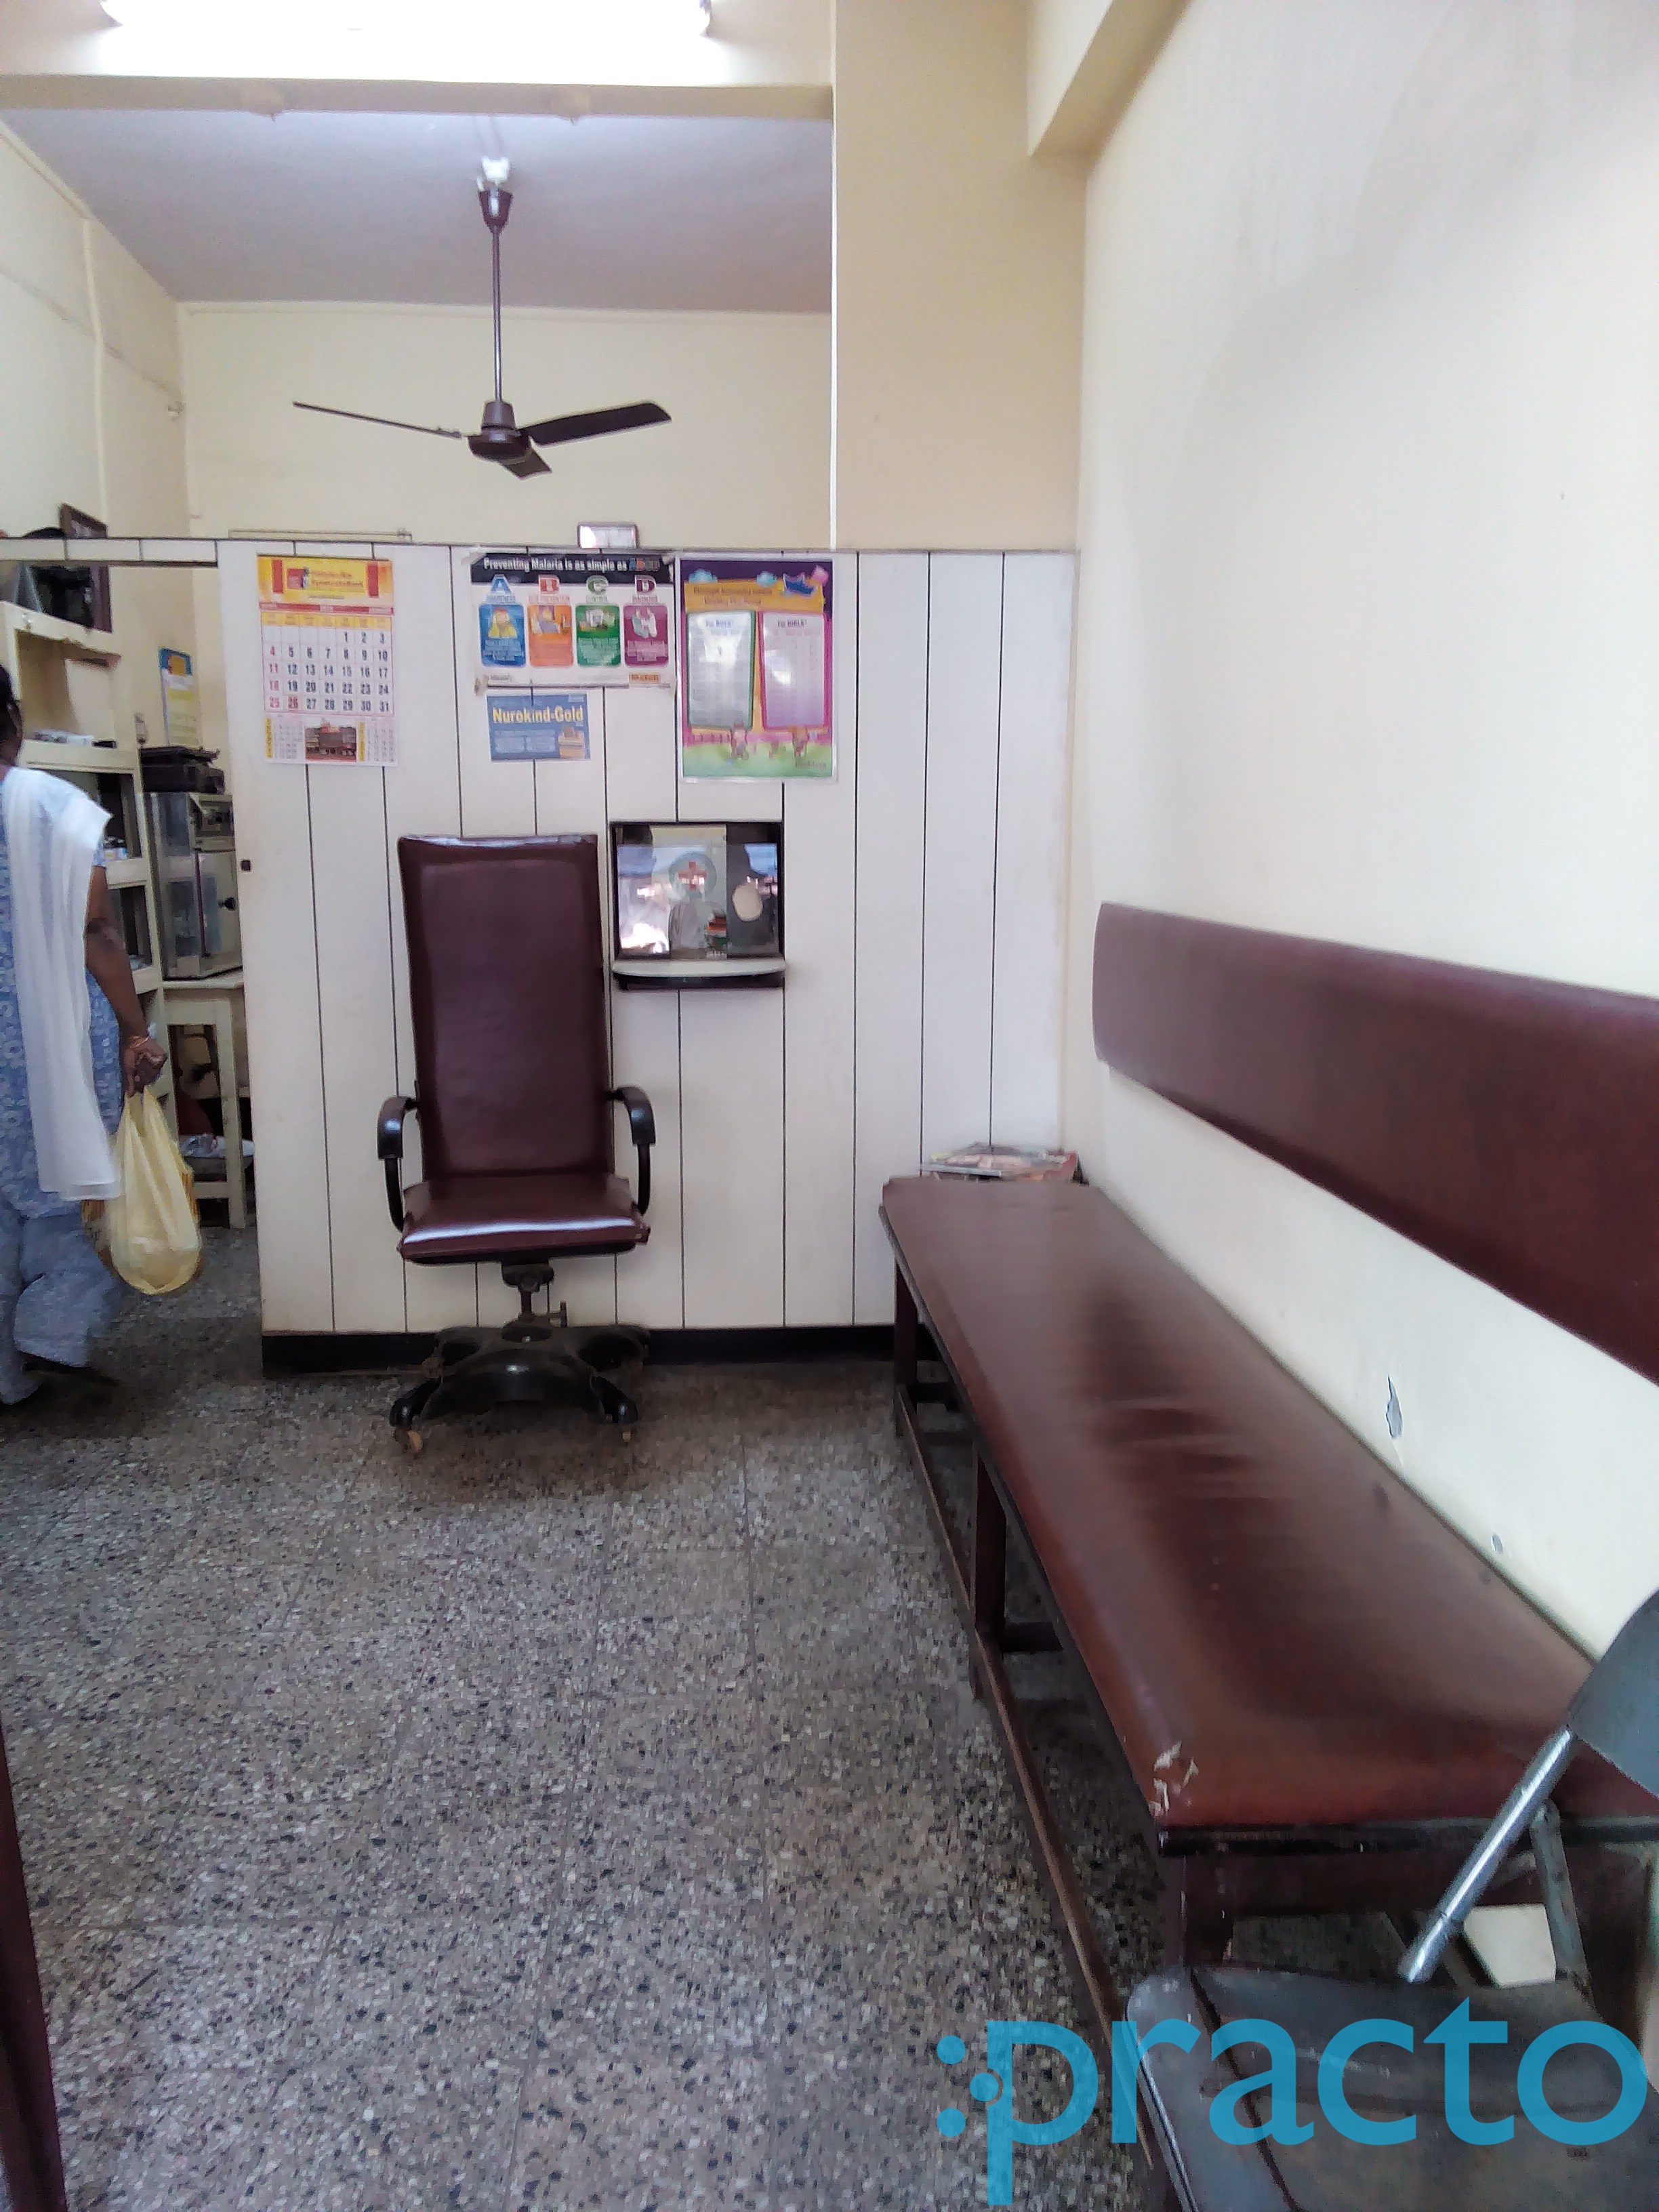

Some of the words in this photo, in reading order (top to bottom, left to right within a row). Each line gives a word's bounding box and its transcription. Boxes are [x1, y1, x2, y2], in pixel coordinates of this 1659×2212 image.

[484, 558, 530, 573] Preventing
[531, 558, 562, 571] Malaria
[565, 558, 573, 571] is
[587, 559, 615, 573] simple
[617, 560, 628, 571] as
[491, 574, 511, 594] A
[344, 632, 348, 643] 1
[361, 632, 367, 644] 2
[380, 632, 385, 644] 3
[270, 645, 275, 656] 4
[289, 646, 294, 658] 5
[307, 647, 313, 659] 6
[325, 648, 331, 659] 7
[362, 649, 367, 661] 9
[378, 650, 388, 661] 10
[270, 663, 278, 674] 11
[288, 663, 298, 675] 12
[306, 663, 315, 676] 13
[324, 664, 333, 676] 14
[361, 666, 370, 678] 16
[379, 667, 388, 678] 17
[288, 680, 298, 692] 19
[306, 680, 316, 693] 20
[325, 682, 334, 694] 21
[342, 682, 352, 694] 22
[361, 682, 371, 695] 23
[379, 684, 389, 695] 24
[306, 698, 316, 710] 27
[343, 699, 353, 711] 29
[361, 700, 371, 712] 30
[379, 701, 389, 712] 31
[492, 704, 583, 724] Nurokind-Gold
